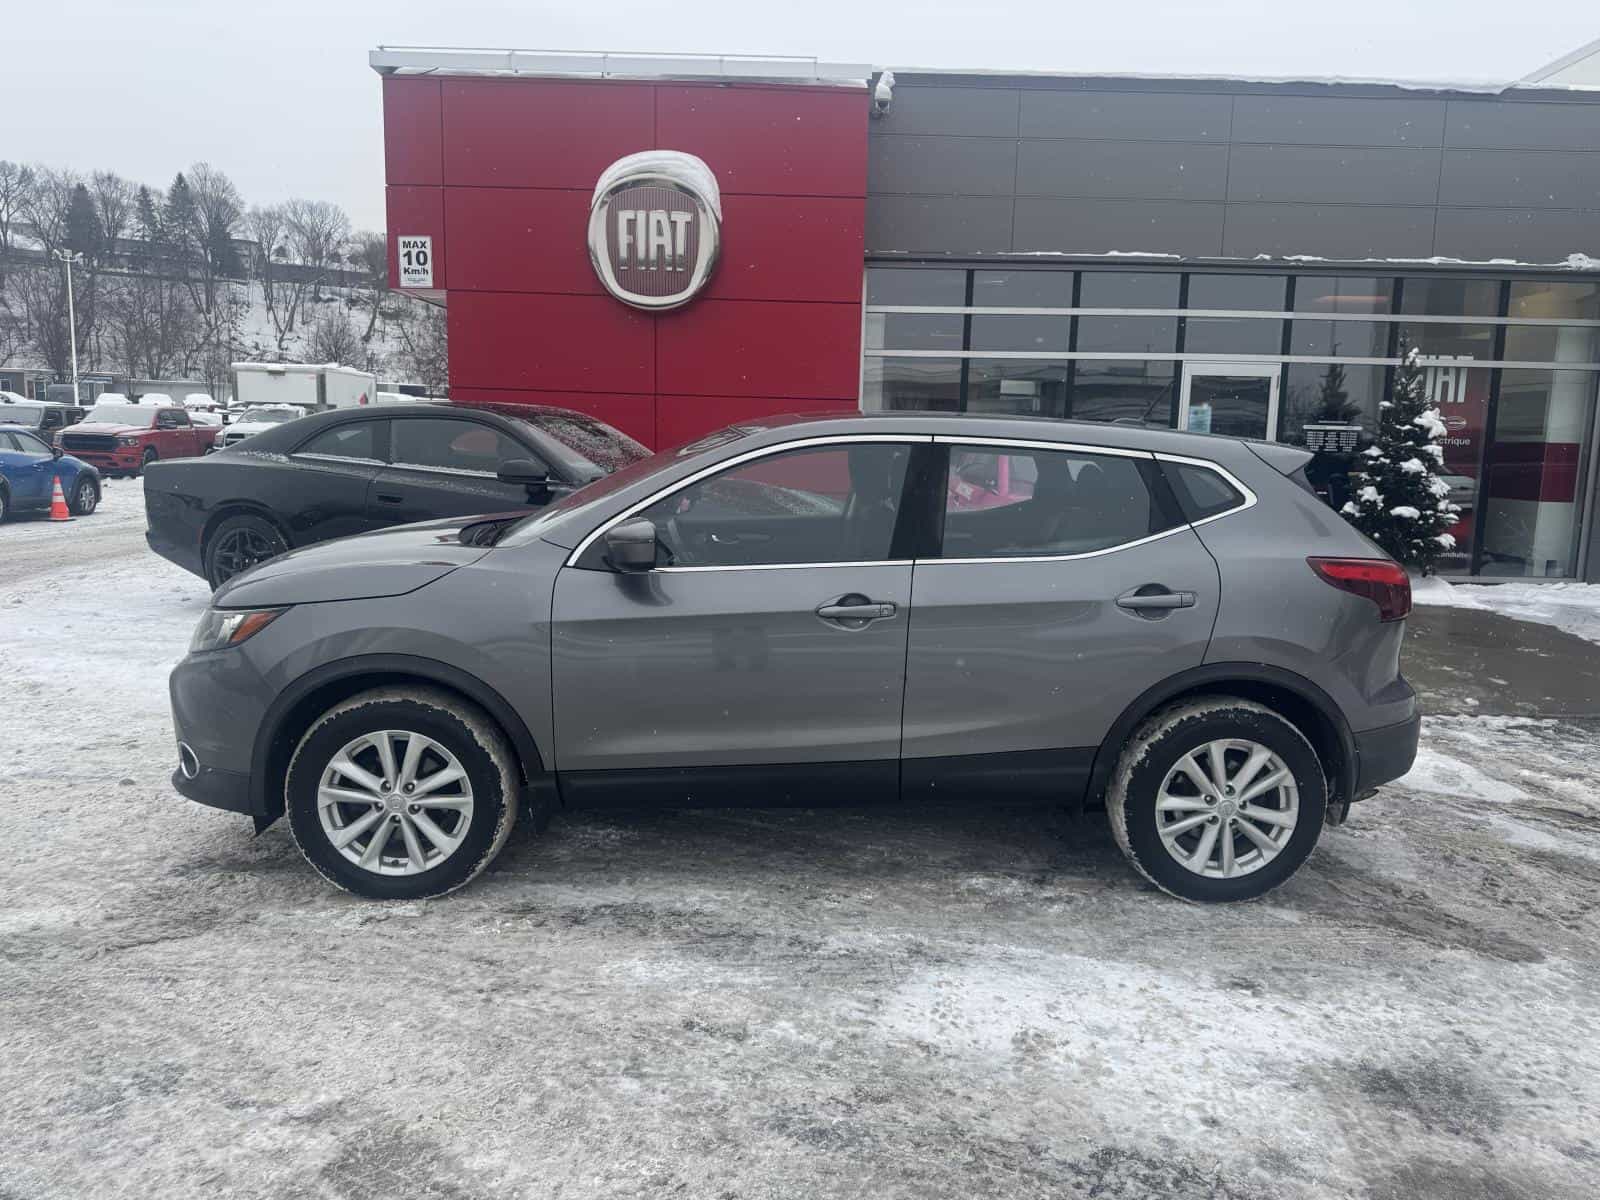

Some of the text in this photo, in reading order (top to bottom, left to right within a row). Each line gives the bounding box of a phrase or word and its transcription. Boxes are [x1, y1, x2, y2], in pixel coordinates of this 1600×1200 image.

[402, 240, 427, 249] MAX
[617, 209, 693, 272] FIAT
[402, 250, 428, 266] 10
[1438, 436, 1471, 448] ctrique
